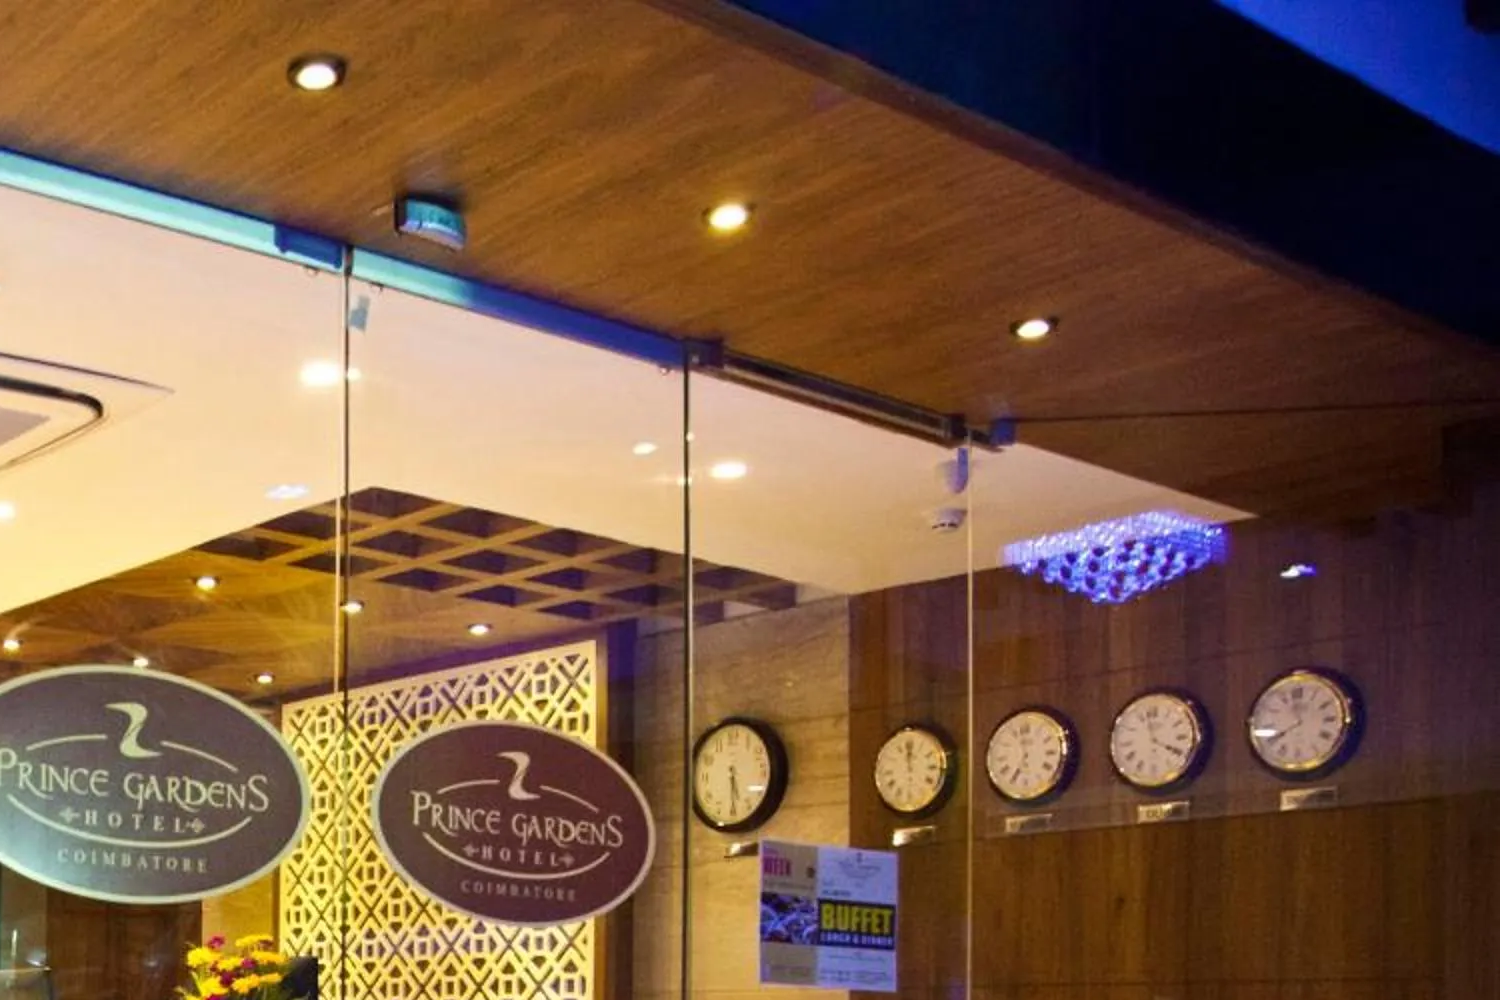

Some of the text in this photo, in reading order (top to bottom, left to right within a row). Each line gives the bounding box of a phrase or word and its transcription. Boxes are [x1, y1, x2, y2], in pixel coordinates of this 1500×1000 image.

[123, 772, 269, 813] GARDENS
[84, 808, 187, 834] HOTEL
[410, 790, 624, 848] PRINCE GARDENS
[57, 848, 208, 874] COIMBATORE
[481, 846, 560, 867] HOTEL
[459, 878, 577, 902] COIMBATORE
[821, 903, 893, 935] BUFFET
